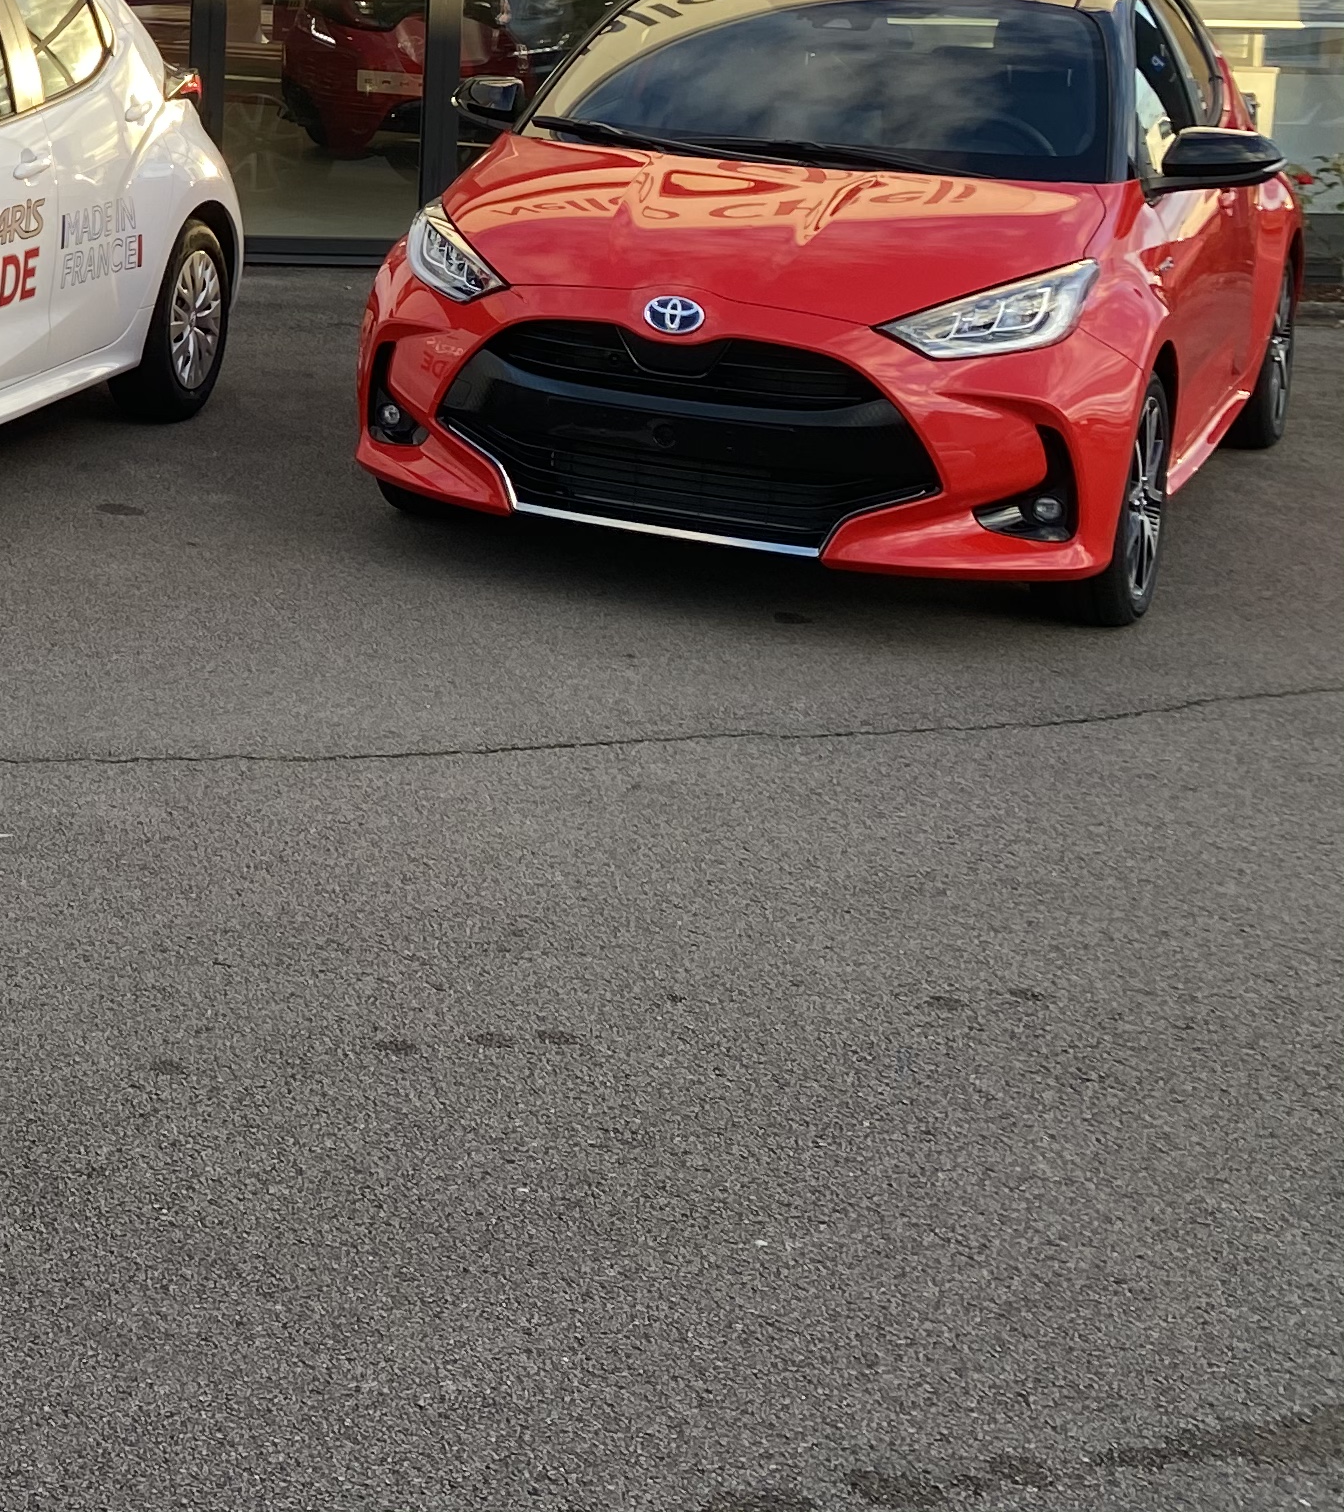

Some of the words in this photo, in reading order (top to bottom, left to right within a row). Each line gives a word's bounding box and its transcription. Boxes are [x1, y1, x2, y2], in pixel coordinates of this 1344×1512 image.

[64, 202, 113, 246] MADE
[116, 196, 136, 233] IN
[60, 235, 137, 289] FRANCE
